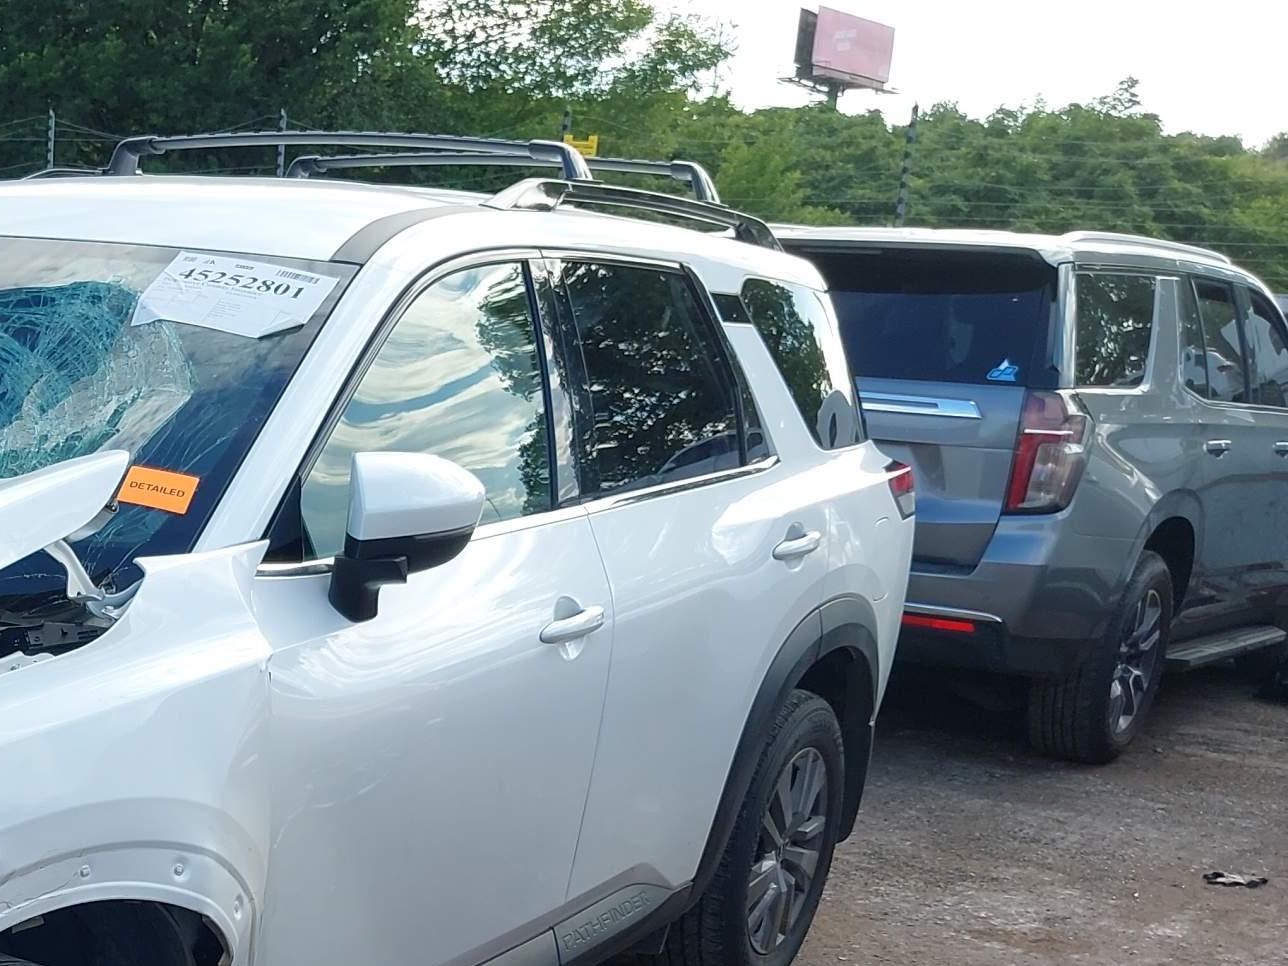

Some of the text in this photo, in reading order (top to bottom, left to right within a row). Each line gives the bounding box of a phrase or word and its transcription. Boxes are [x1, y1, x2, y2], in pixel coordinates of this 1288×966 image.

[179, 267, 305, 300] 45252801
[129, 480, 185, 498] DETAILED
[562, 889, 651, 953] PATHFINDER
